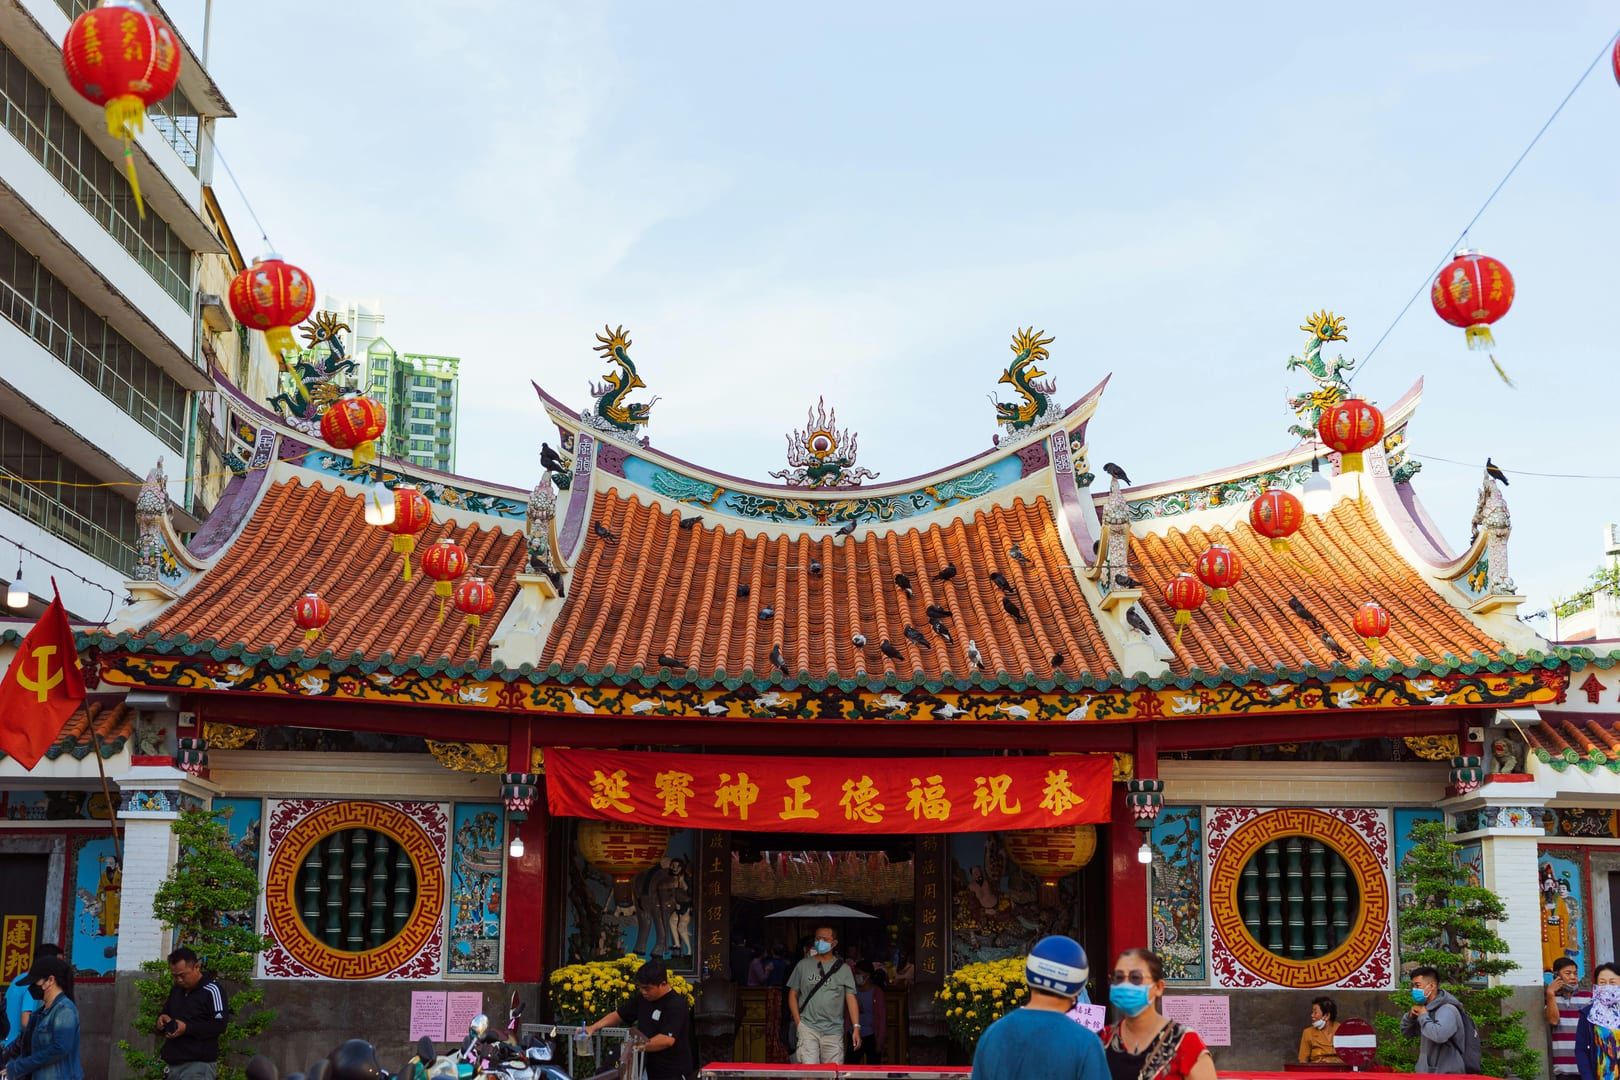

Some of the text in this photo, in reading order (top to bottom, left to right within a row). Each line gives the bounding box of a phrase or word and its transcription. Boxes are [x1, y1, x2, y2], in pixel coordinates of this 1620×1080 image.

[589, 769, 1084, 823] 恭祝福德正神寶誕
[808, 973, 832, 986] Jep
